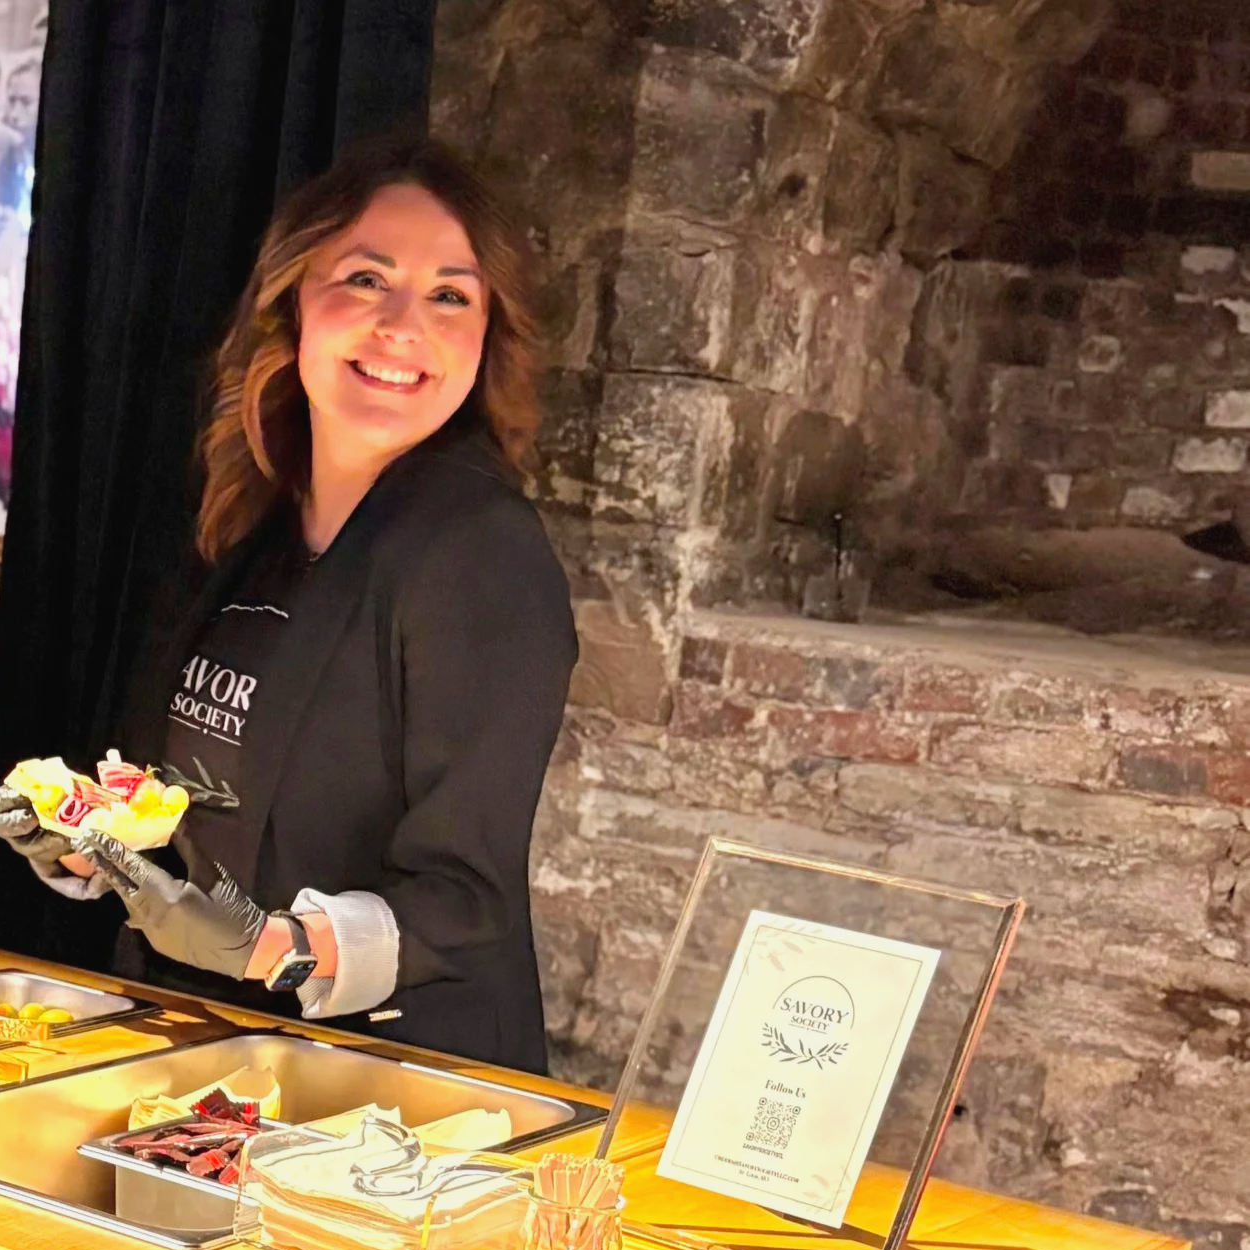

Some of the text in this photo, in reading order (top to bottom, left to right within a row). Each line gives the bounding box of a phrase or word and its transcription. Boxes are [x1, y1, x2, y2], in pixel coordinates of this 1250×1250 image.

[181, 655, 258, 712] AVOR
[170, 692, 246, 737] SOCIETY
[780, 997, 849, 1024] SAVORY
[790, 1015, 830, 1031] SOCIETY
[765, 1079, 807, 1099] Follow Us
